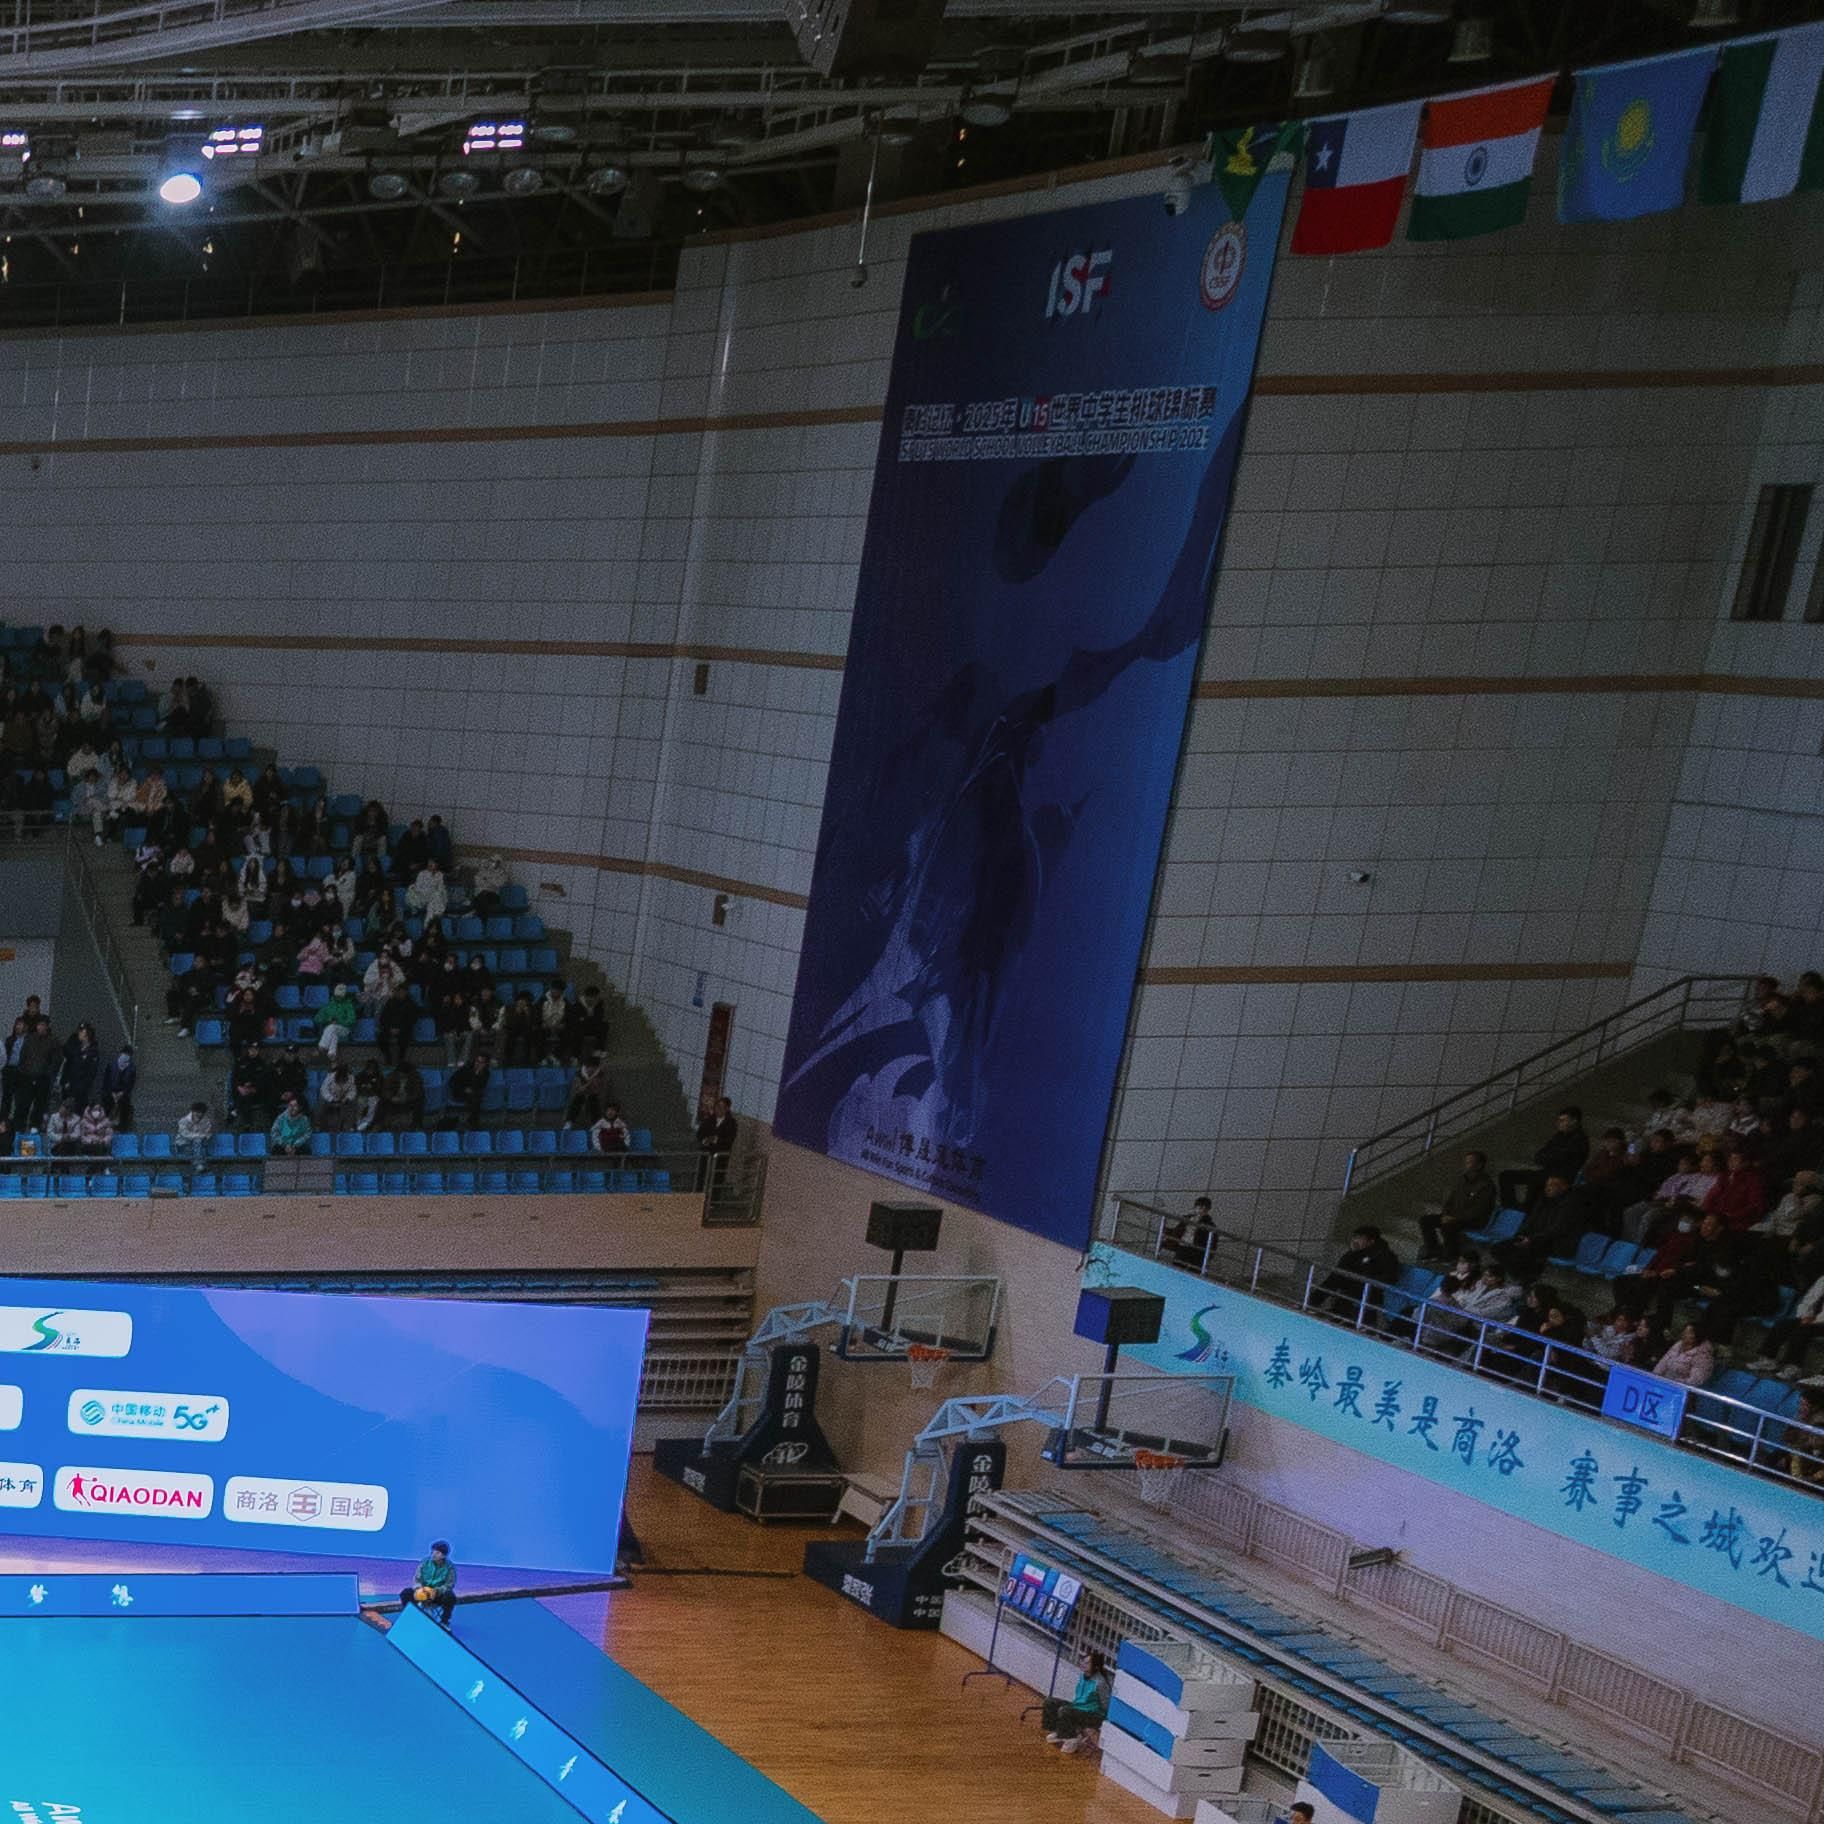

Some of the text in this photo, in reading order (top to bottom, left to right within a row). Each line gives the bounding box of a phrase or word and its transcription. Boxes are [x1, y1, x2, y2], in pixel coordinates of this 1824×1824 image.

[1044, 250, 1113, 318] ISF
[111, 1403, 166, 1417] 中国移动
[1264, 1337, 1525, 1477] 秦岭最美是商洛
[1623, 1386, 1664, 1425] D区
[90, 1484, 203, 1508] QIAODAN
[236, 1490, 278, 1512] 商洛
